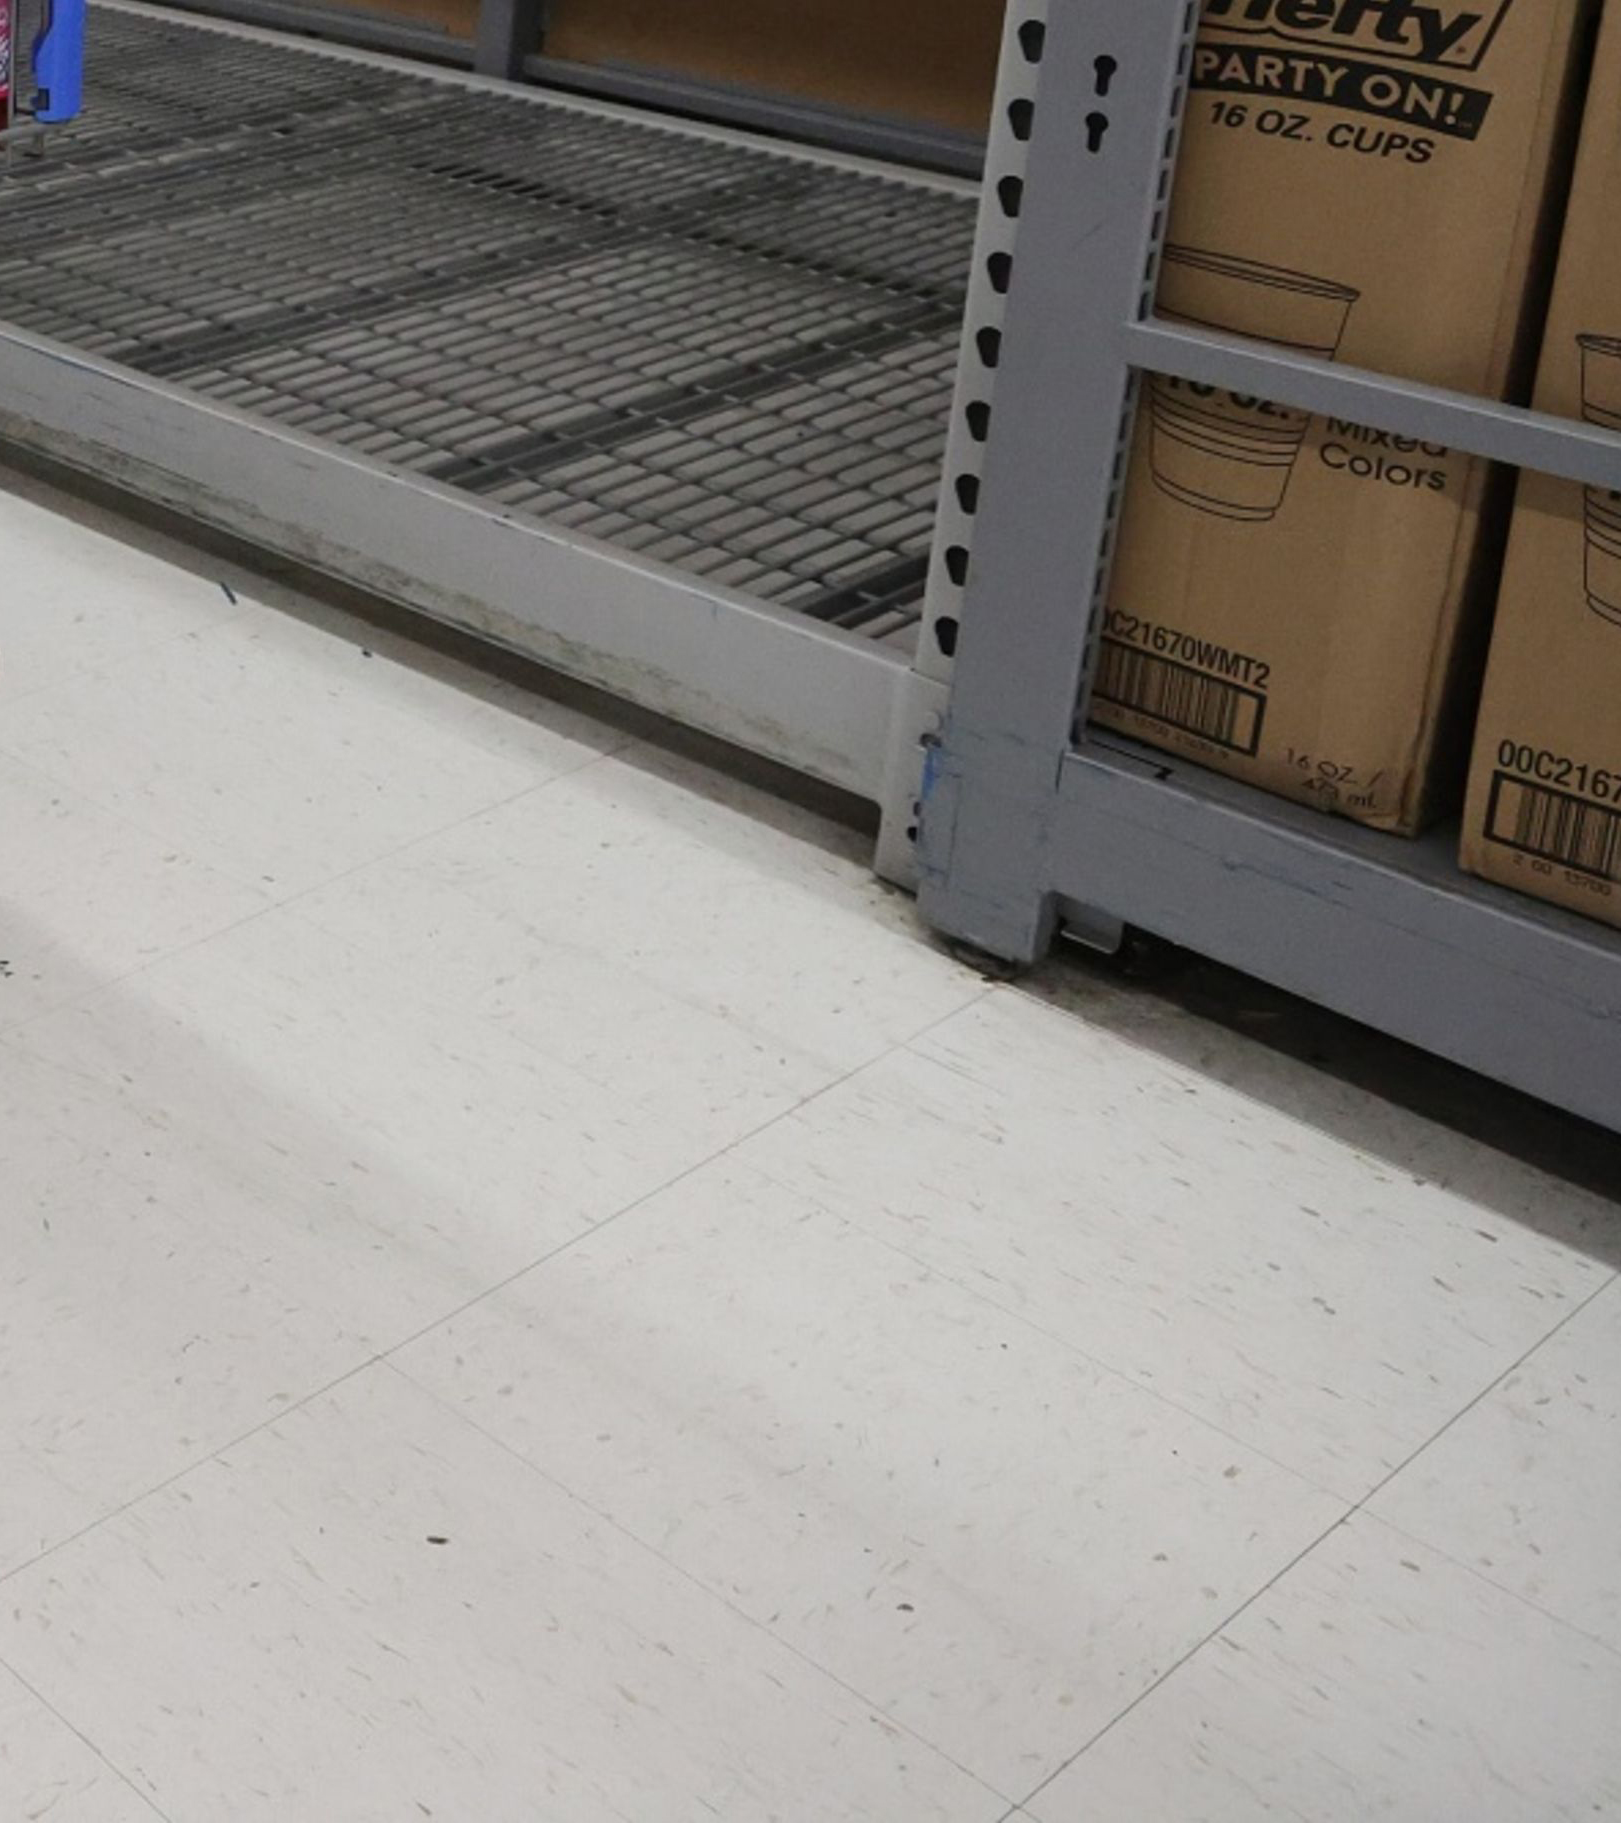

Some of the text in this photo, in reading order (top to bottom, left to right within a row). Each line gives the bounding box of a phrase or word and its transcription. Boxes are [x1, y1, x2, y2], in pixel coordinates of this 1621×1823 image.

[1195, 49, 1465, 127] PARTY ON!
[1211, 101, 1436, 164] 16 OZ. CUPS
[1319, 442, 1448, 492] Colors
[1285, 747, 1310, 770] 16
